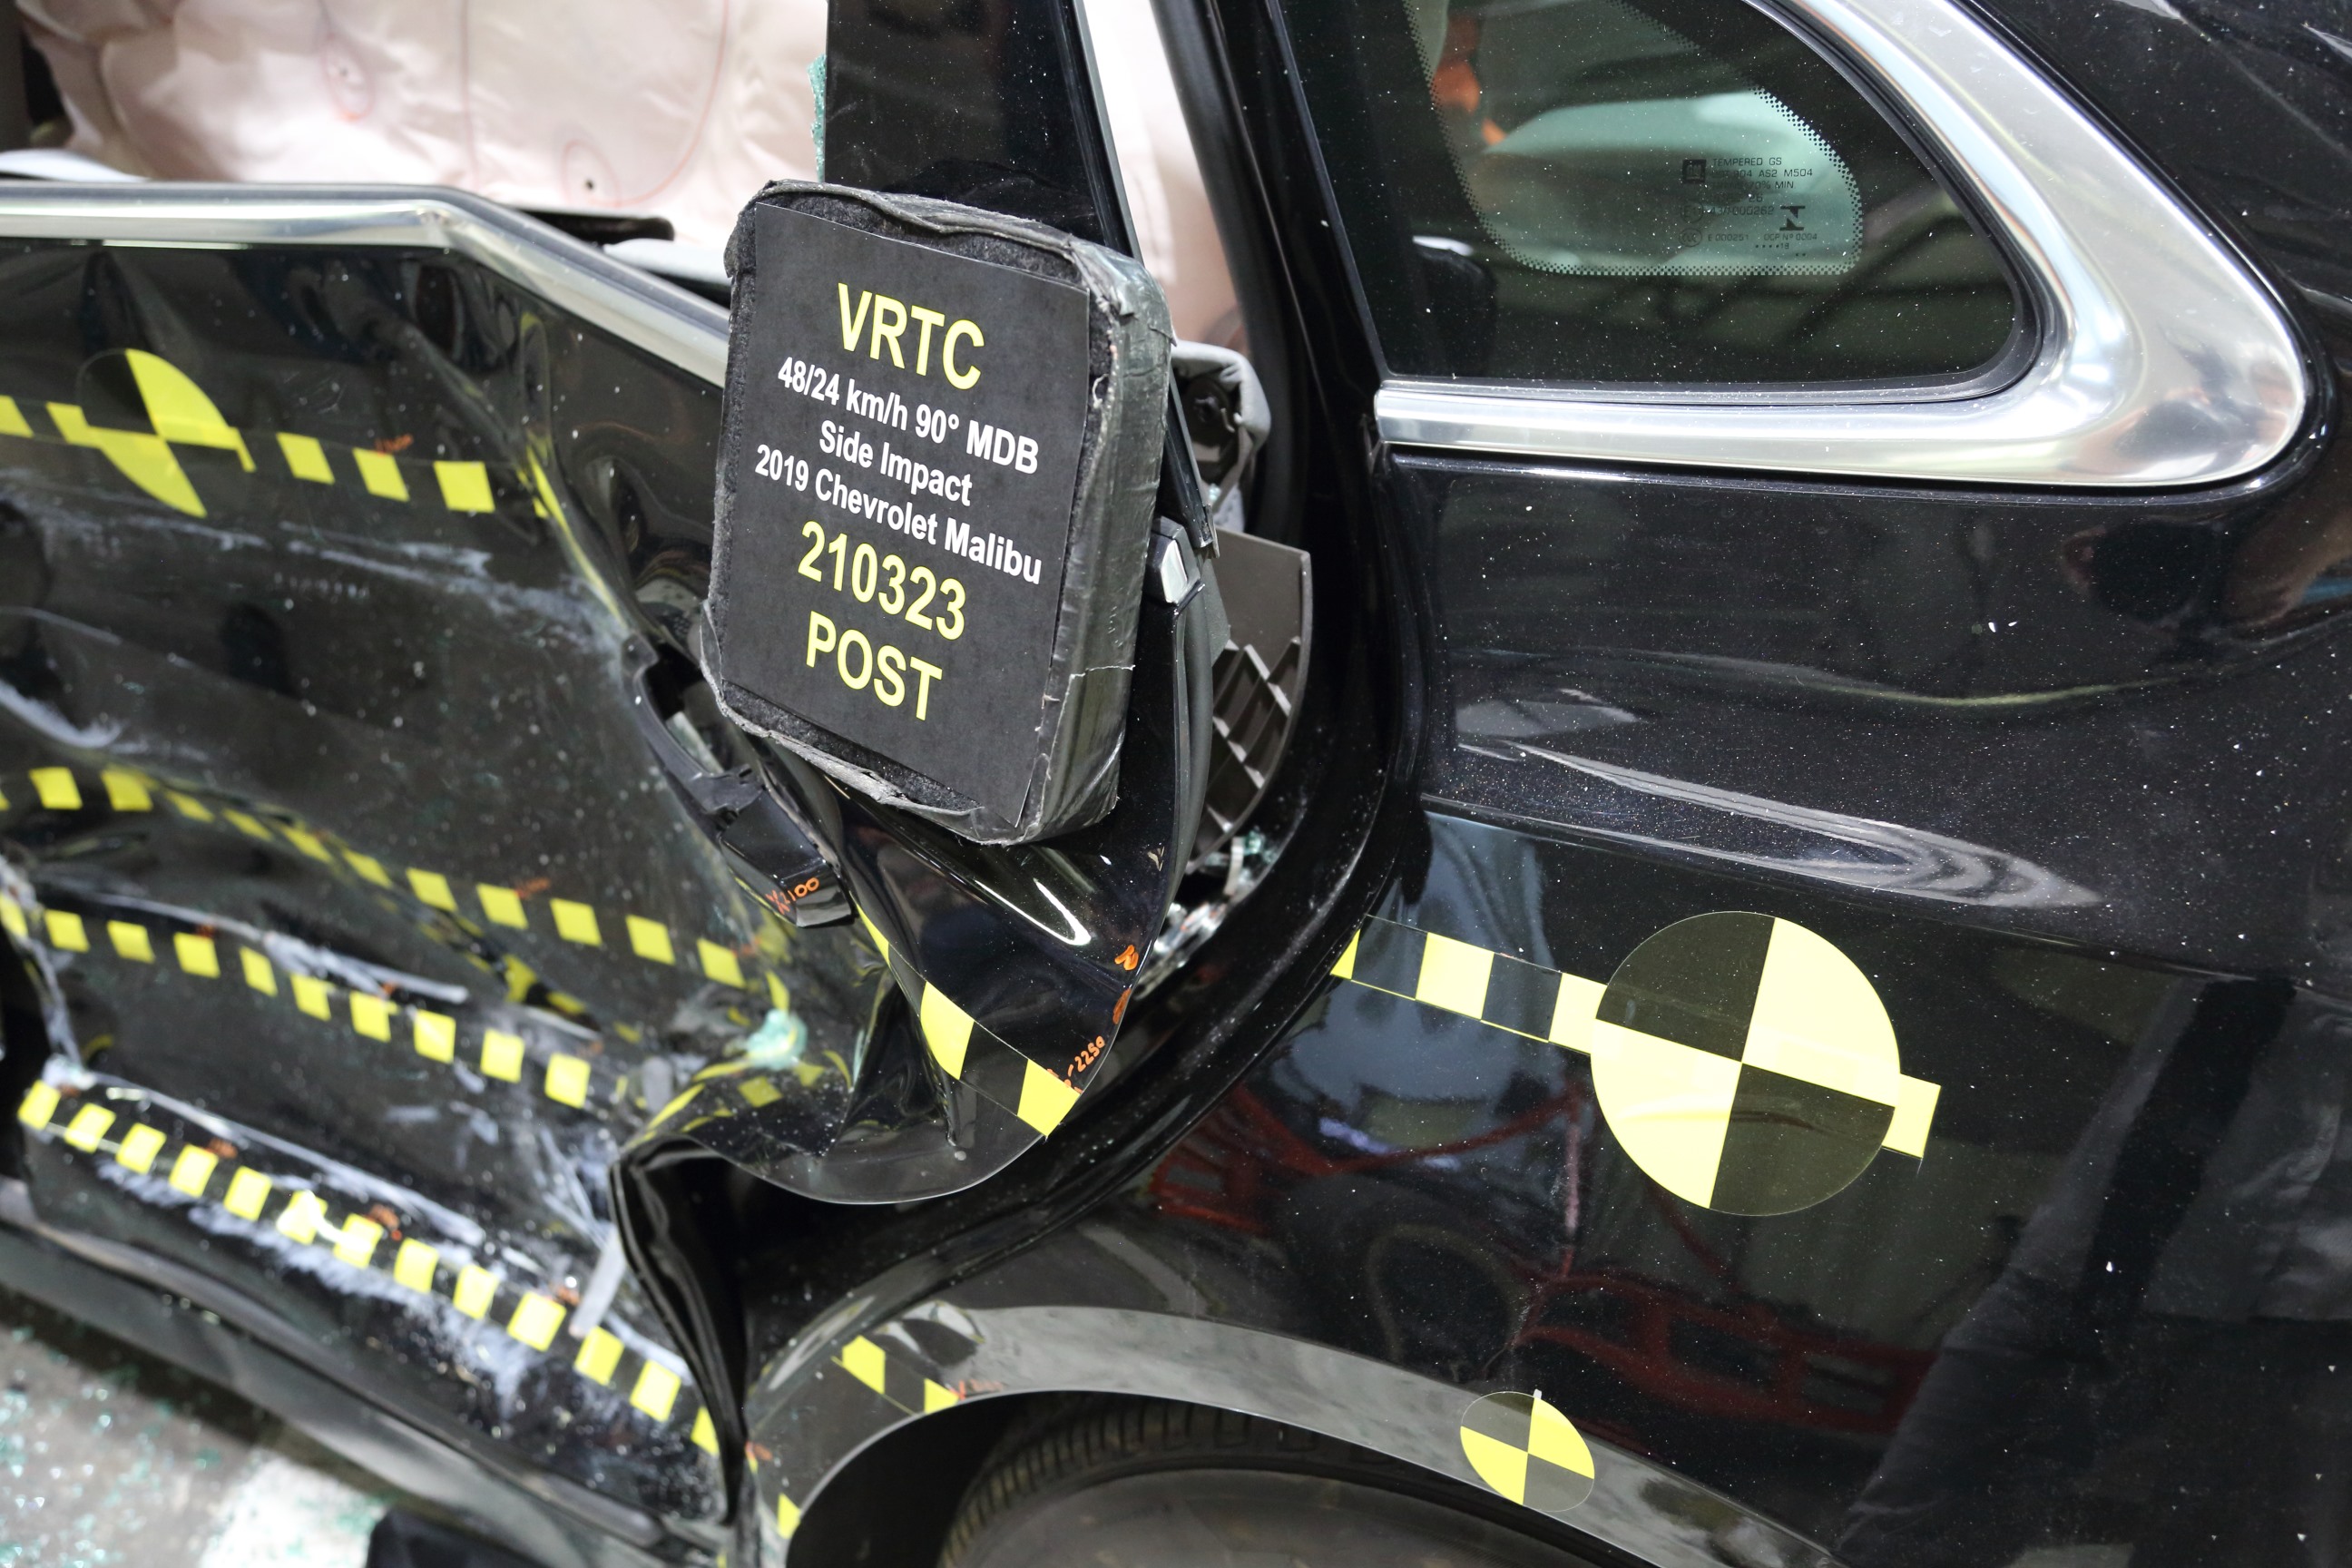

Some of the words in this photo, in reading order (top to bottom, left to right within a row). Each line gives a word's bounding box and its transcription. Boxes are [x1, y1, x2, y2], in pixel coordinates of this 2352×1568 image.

[1712, 157, 1763, 167] TEMPERED
[1769, 157, 1782, 166] GS
[1759, 169, 1778, 178] AS2
[1783, 168, 1813, 177] M504
[838, 282, 985, 390] VRTC
[778, 357, 839, 406] 48/24
[846, 382, 907, 431] km/h
[965, 420, 1039, 475] MDB
[819, 419, 874, 468] Side
[880, 441, 973, 506] Impact
[755, 444, 808, 492] 2019
[815, 468, 937, 545] Chevrolet
[945, 517, 1042, 584] Malibu
[797, 520, 965, 641] 210323
[806, 610, 943, 721] POST
